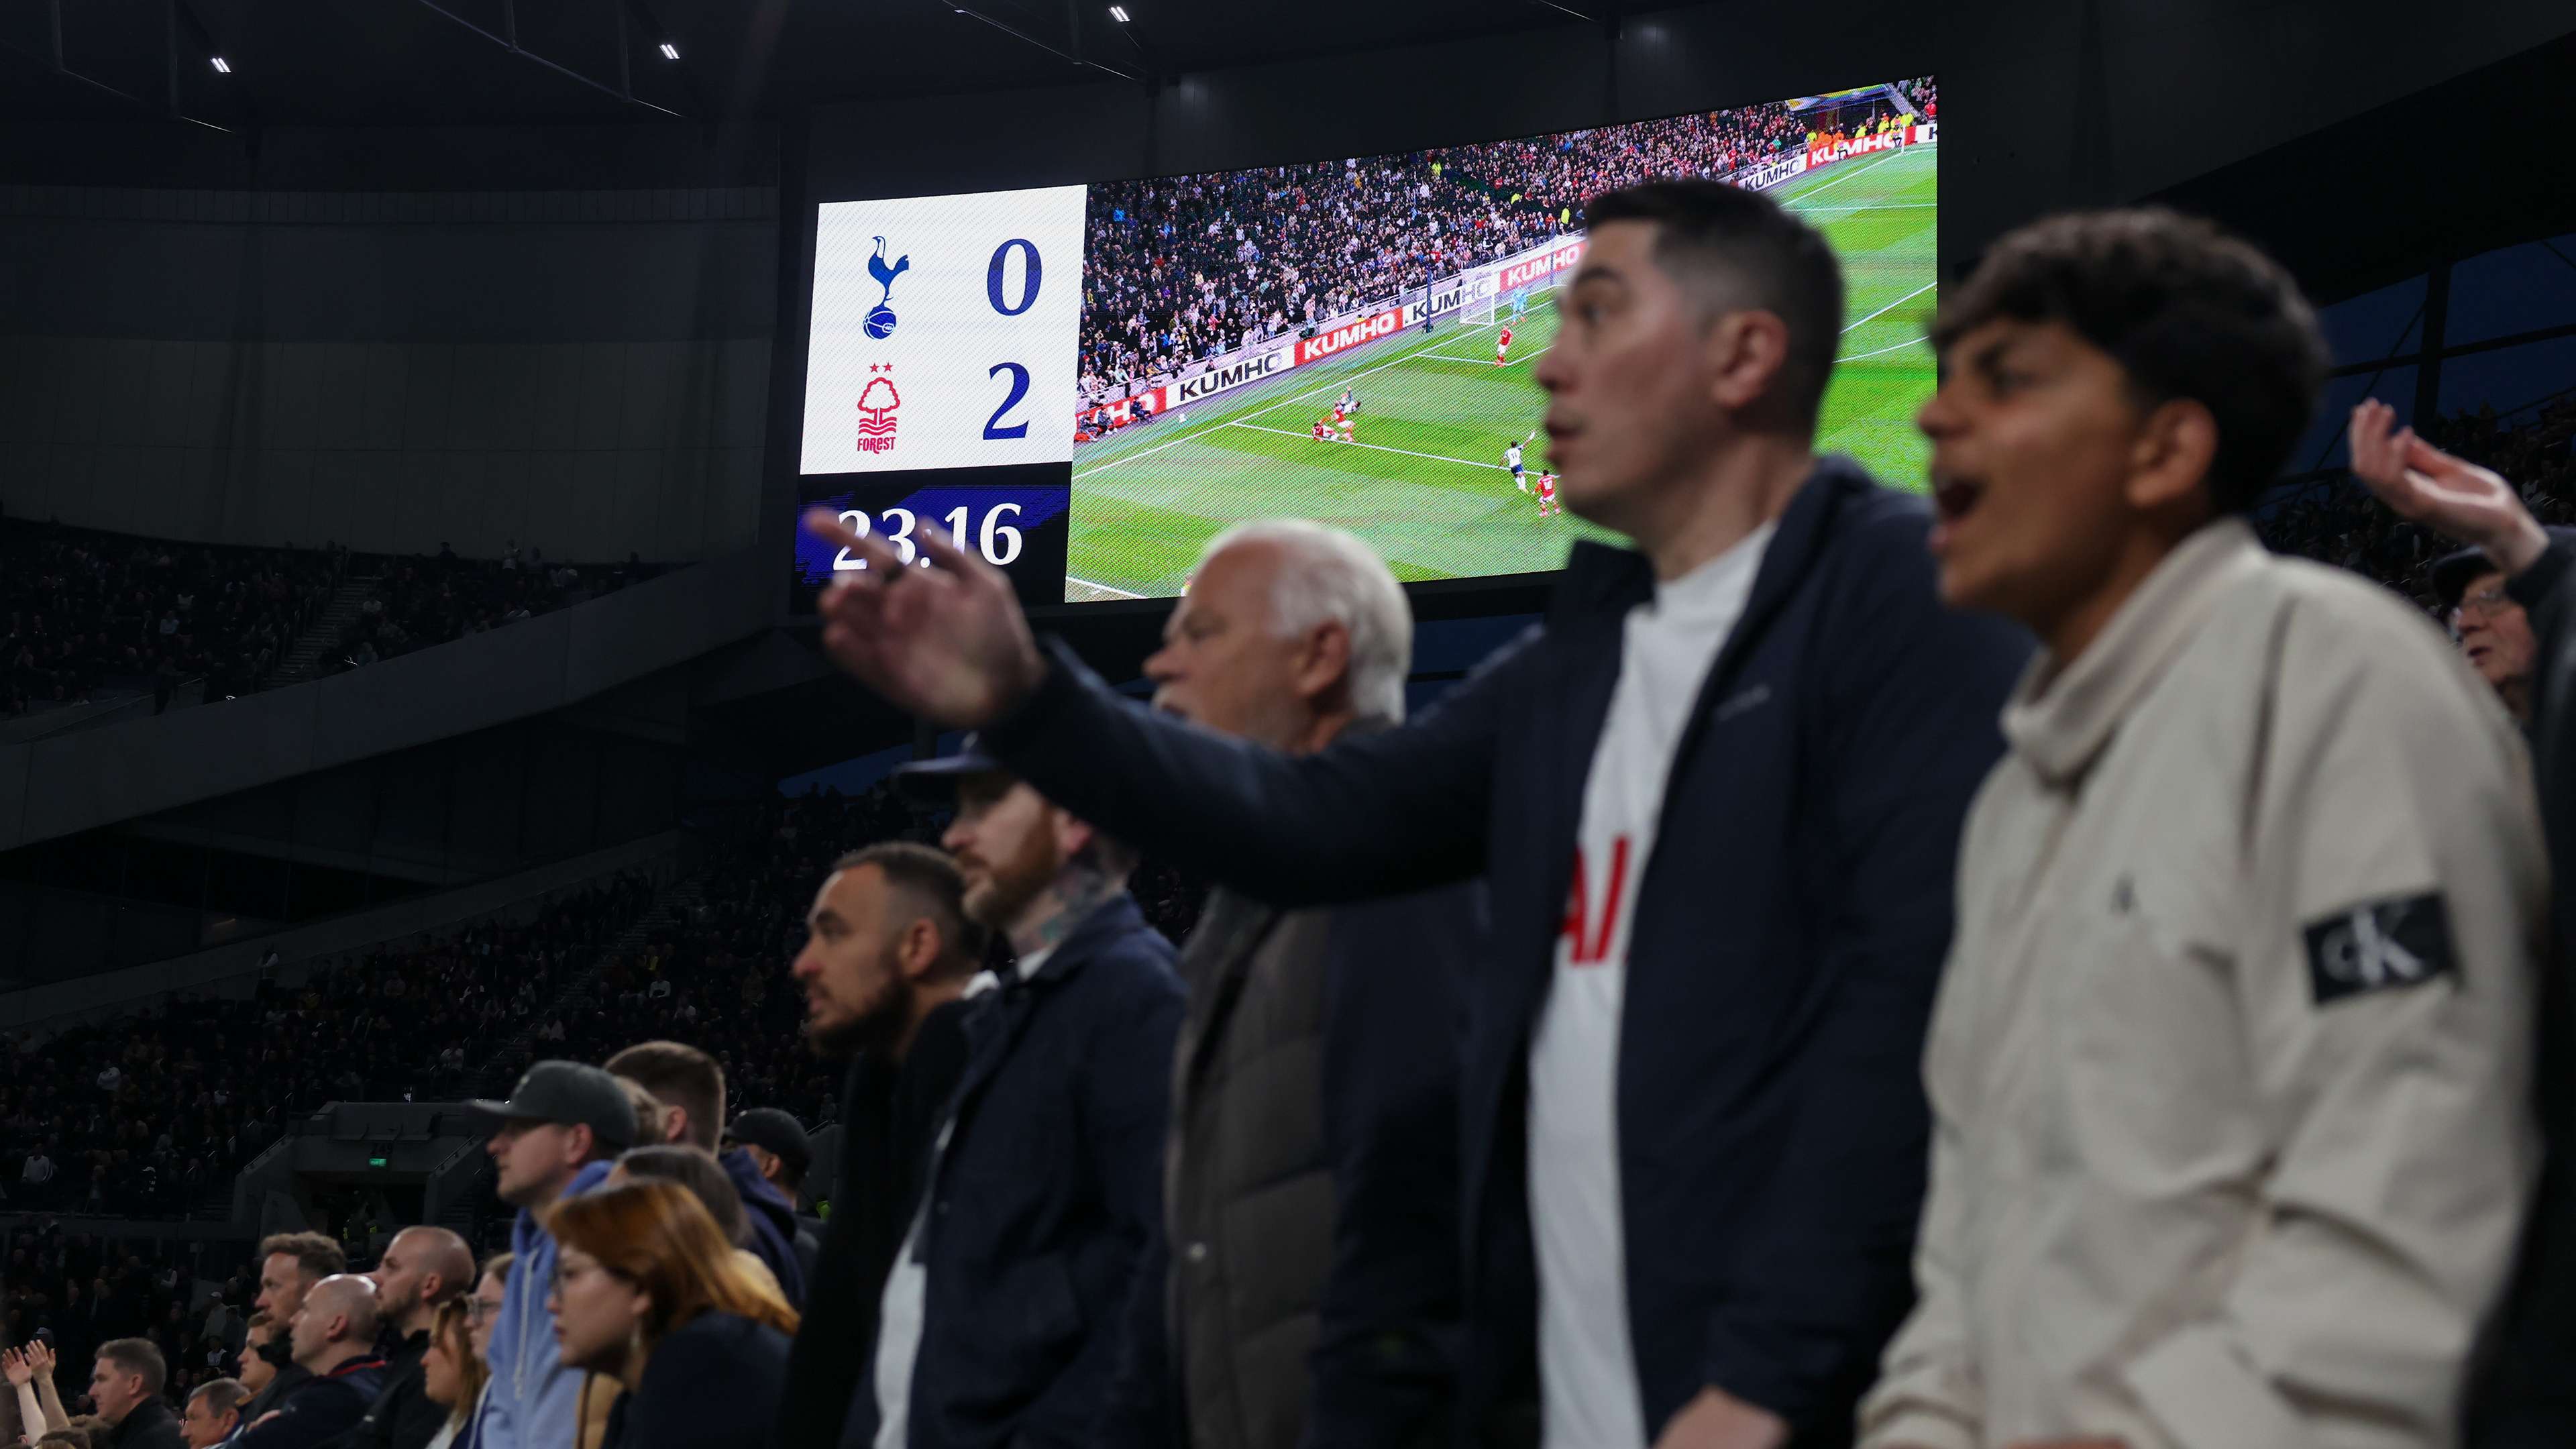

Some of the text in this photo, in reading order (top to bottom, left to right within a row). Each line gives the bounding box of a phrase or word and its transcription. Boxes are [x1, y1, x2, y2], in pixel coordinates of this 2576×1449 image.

[1745, 159, 1799, 192] KUMHO
[986, 238, 1042, 317] 0
[1507, 246, 1580, 286] KUMHO
[1413, 278, 1489, 321] KUMHO
[1304, 312, 1395, 360] KUMHO
[1180, 352, 1283, 402] KUMHO
[982, 362, 1030, 441] 2
[857, 436, 897, 455] FOREST
